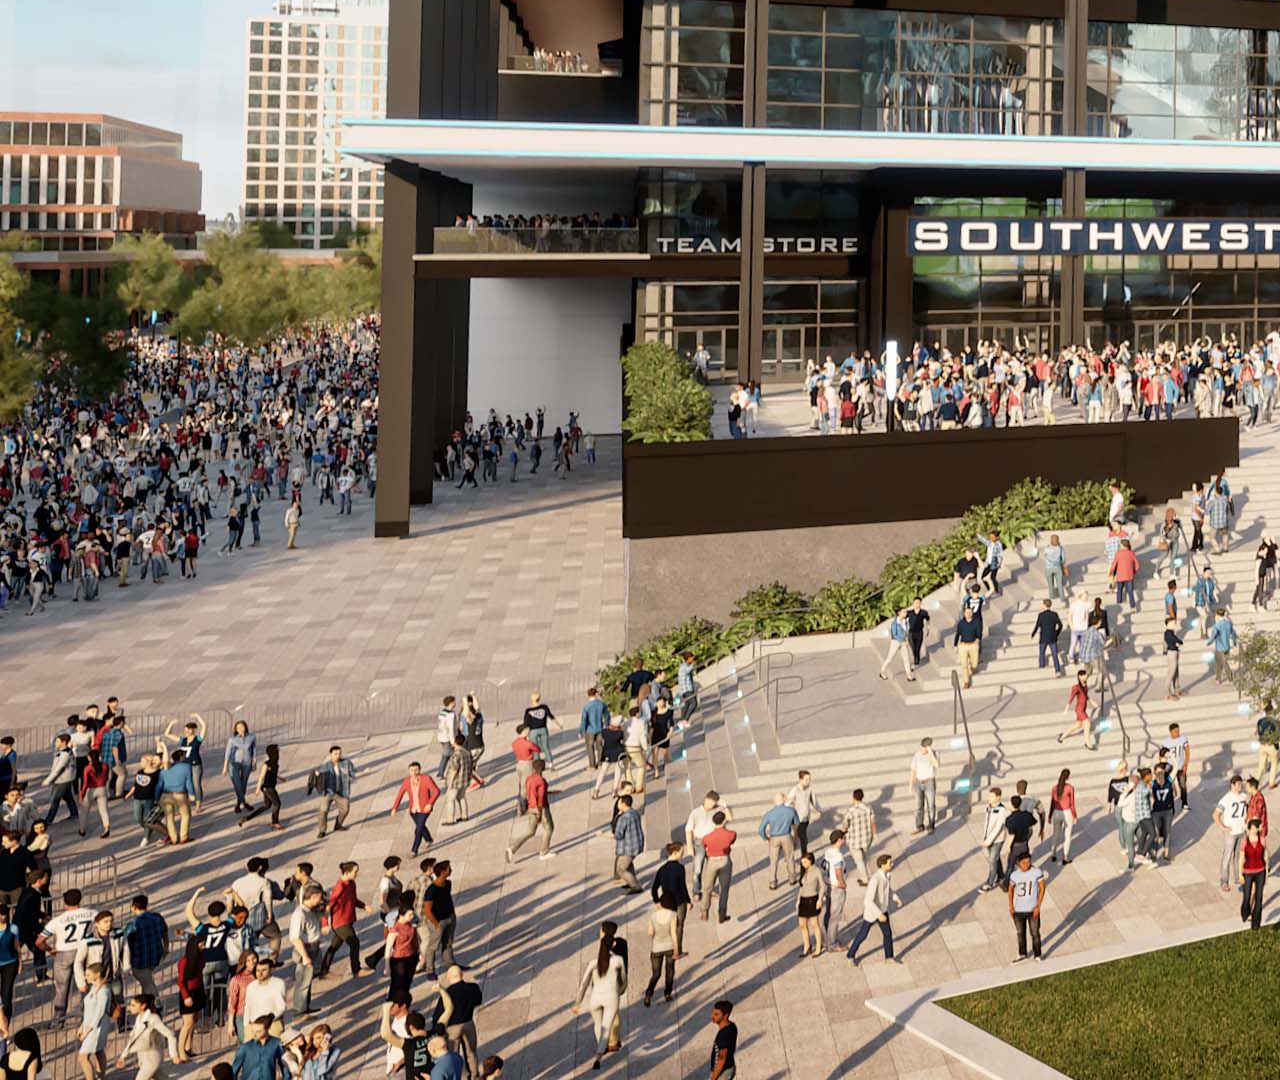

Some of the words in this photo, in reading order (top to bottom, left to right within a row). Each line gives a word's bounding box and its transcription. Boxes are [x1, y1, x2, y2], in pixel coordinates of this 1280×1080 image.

[656, 237, 741, 253] TEAM
[762, 237, 859, 253] STORE
[1231, 801, 1247, 819] 27
[1017, 880, 1033, 898] 31
[205, 932, 225, 949] 17
